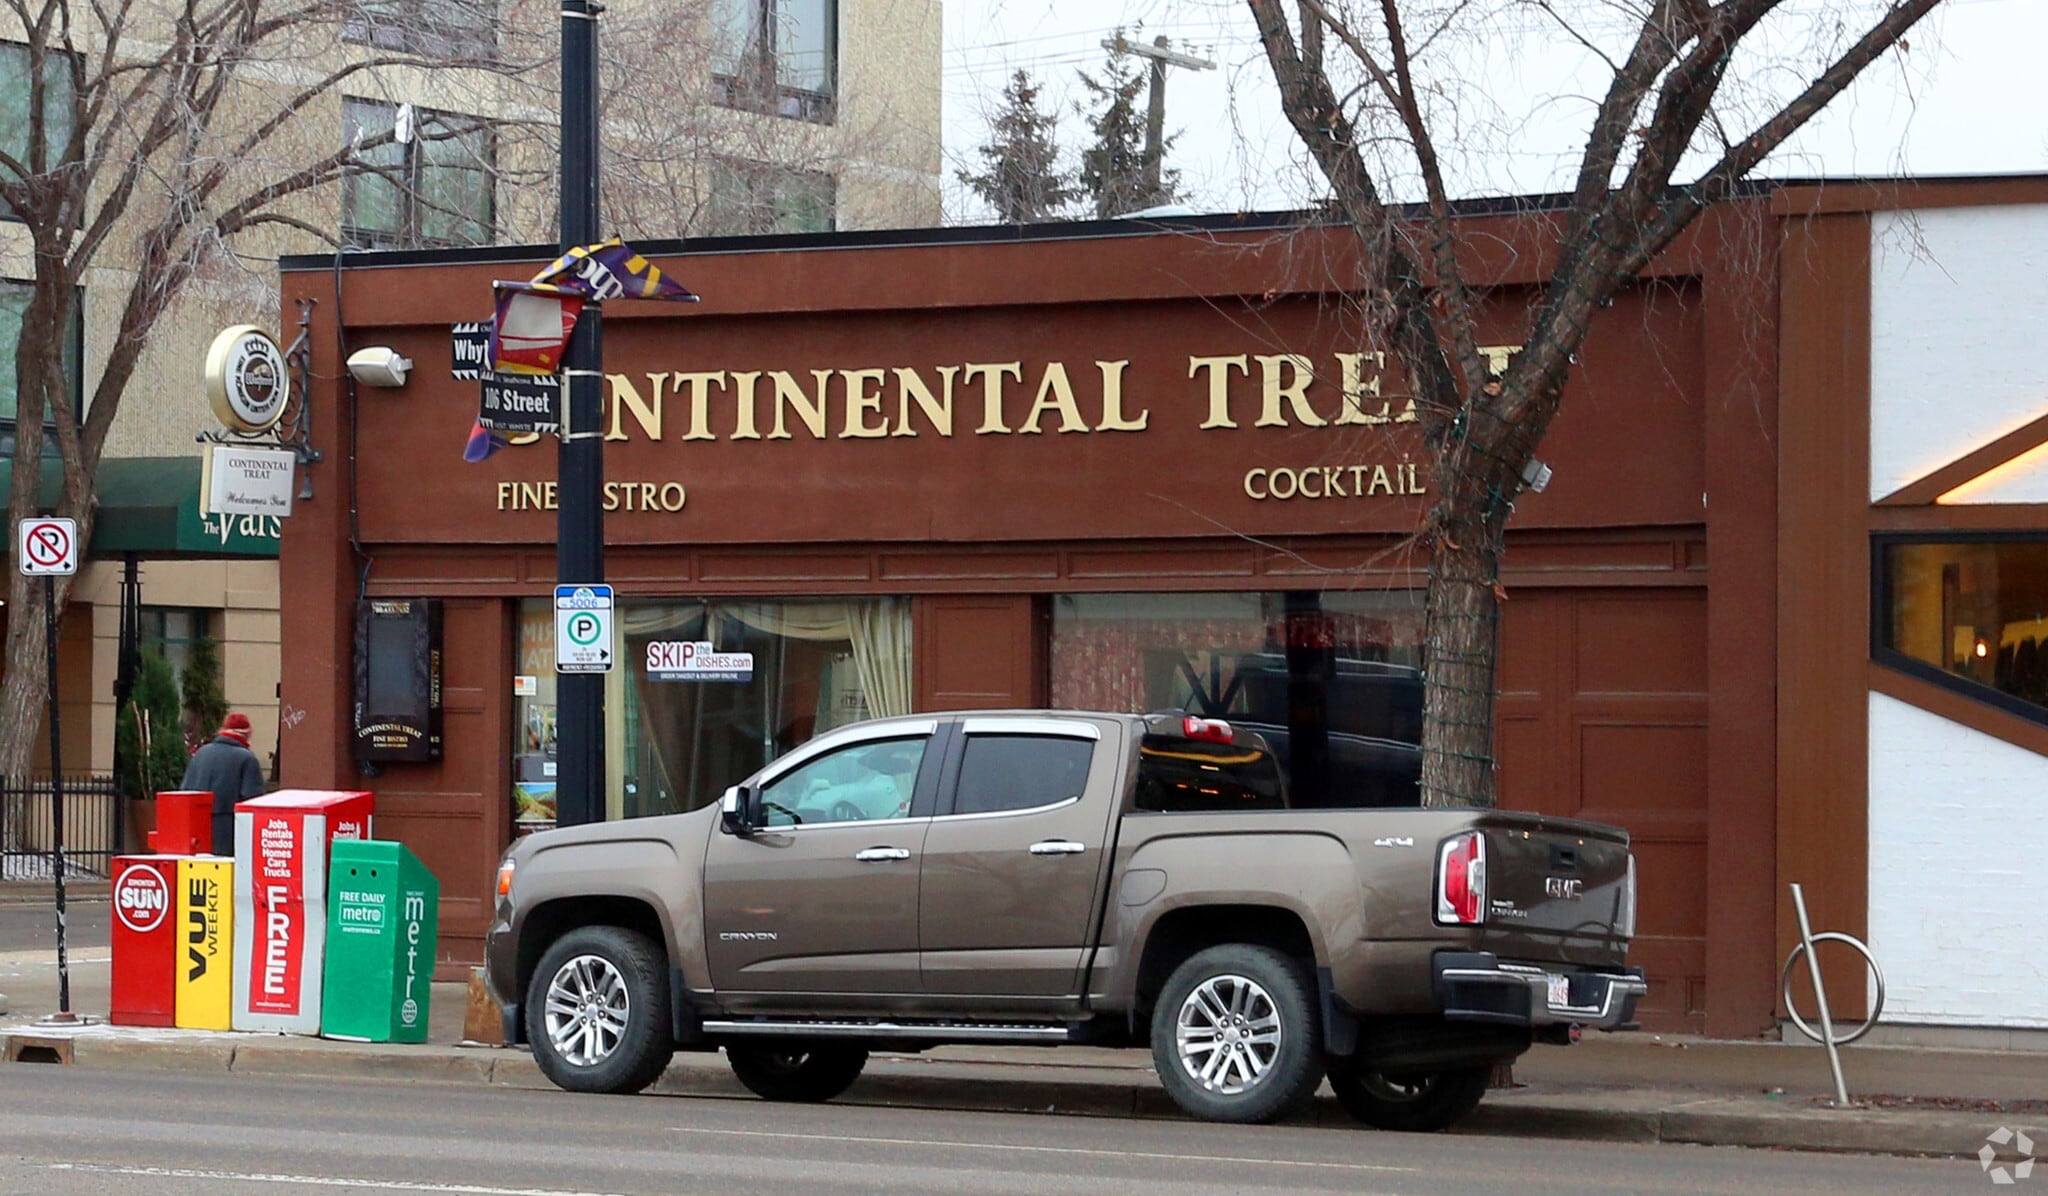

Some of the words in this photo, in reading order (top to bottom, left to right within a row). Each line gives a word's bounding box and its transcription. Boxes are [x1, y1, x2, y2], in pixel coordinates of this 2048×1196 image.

[485, 387, 500, 410] 106
[503, 388, 550, 413] Street
[229, 459, 288, 472] CONTINENTAL
[244, 469, 271, 480] TREAT
[1244, 463, 1426, 499] COCKTAIL
[497, 482, 559, 510] FINE
[602, 482, 686, 511] STRO
[569, 598, 598, 609] 5006
[696, 644, 711, 655] the
[649, 644, 694, 668] SKIP
[696, 656, 751, 669] DISHES.com
[268, 819, 288, 829] Jobs
[338, 821, 355, 831] Jobs
[262, 829, 293, 839] Rentals
[261, 839, 293, 849] Condos
[262, 849, 292, 858] Homes
[267, 858, 287, 868] Cars
[263, 868, 291, 878] Trucks
[121, 887, 163, 909] SUN
[340, 891, 360, 902] FREE
[361, 892, 386, 903] DAILY
[208, 879, 219, 956] WEEKLY
[342, 907, 381, 922] metro
[189, 878, 206, 983] VUE
[719, 932, 778, 941] CANYON
[264, 885, 290, 994] FREE
